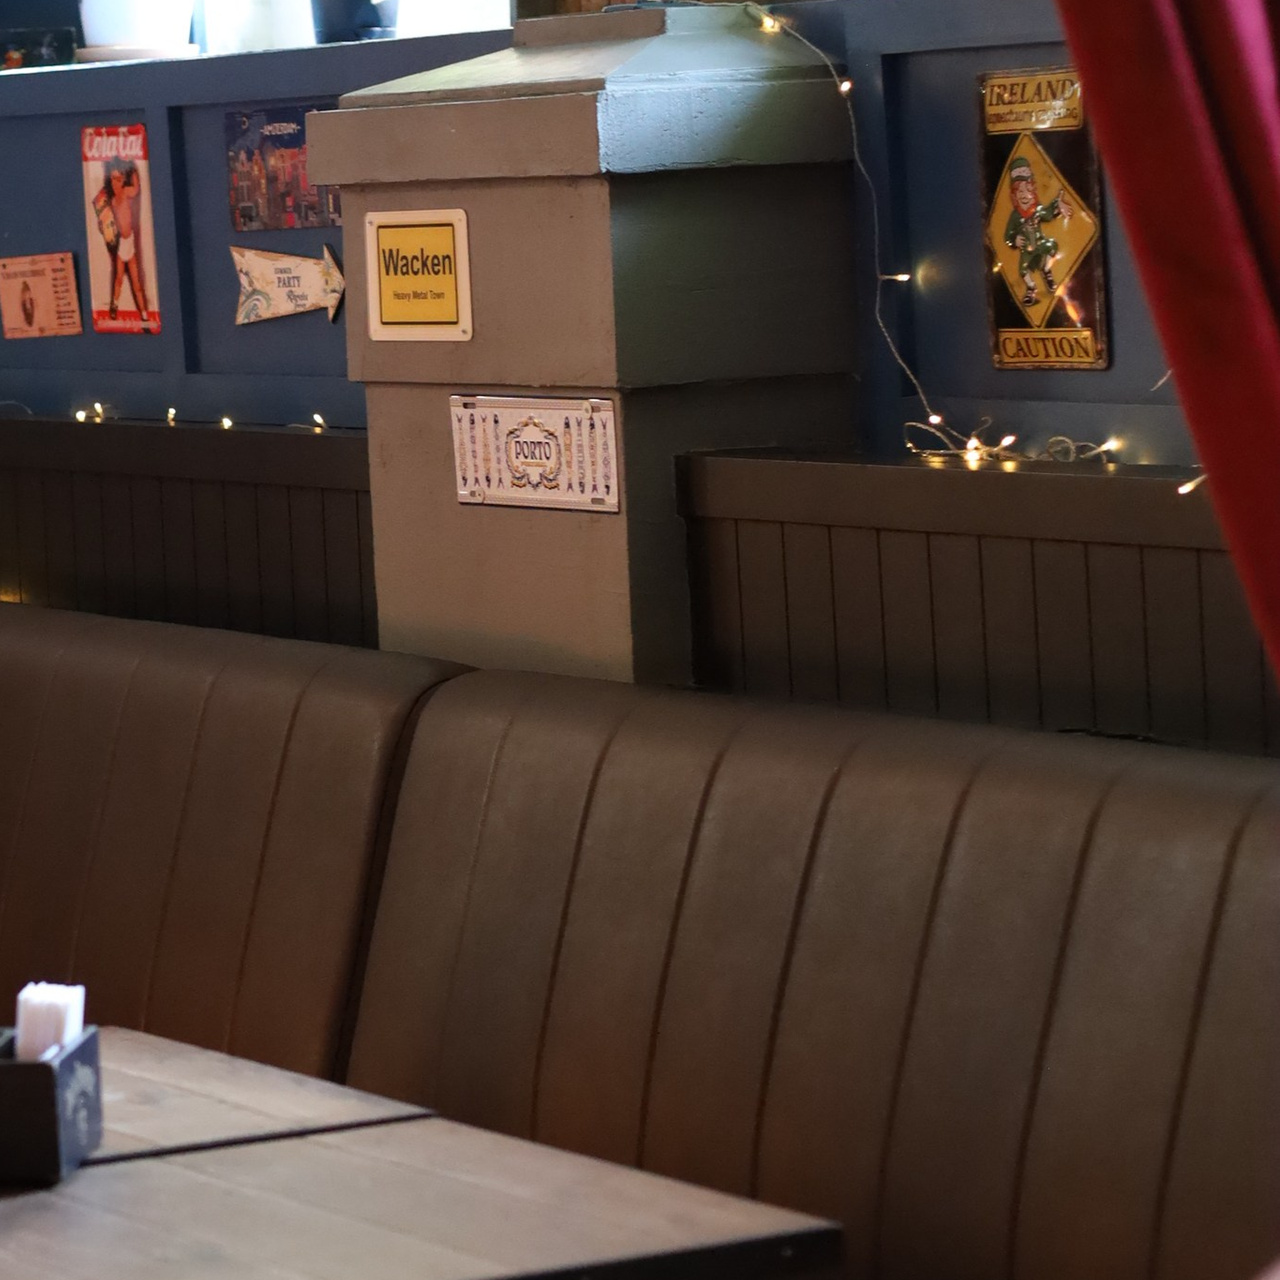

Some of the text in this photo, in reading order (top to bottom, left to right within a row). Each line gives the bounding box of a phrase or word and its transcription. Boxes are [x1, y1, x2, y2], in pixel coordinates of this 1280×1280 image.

[988, 78, 1075, 106] IRELAND
[382, 247, 453, 276] Wacken
[277, 276, 301, 288] PARTY
[1002, 336, 1091, 359] CAUTION
[515, 440, 552, 461] PORTO
